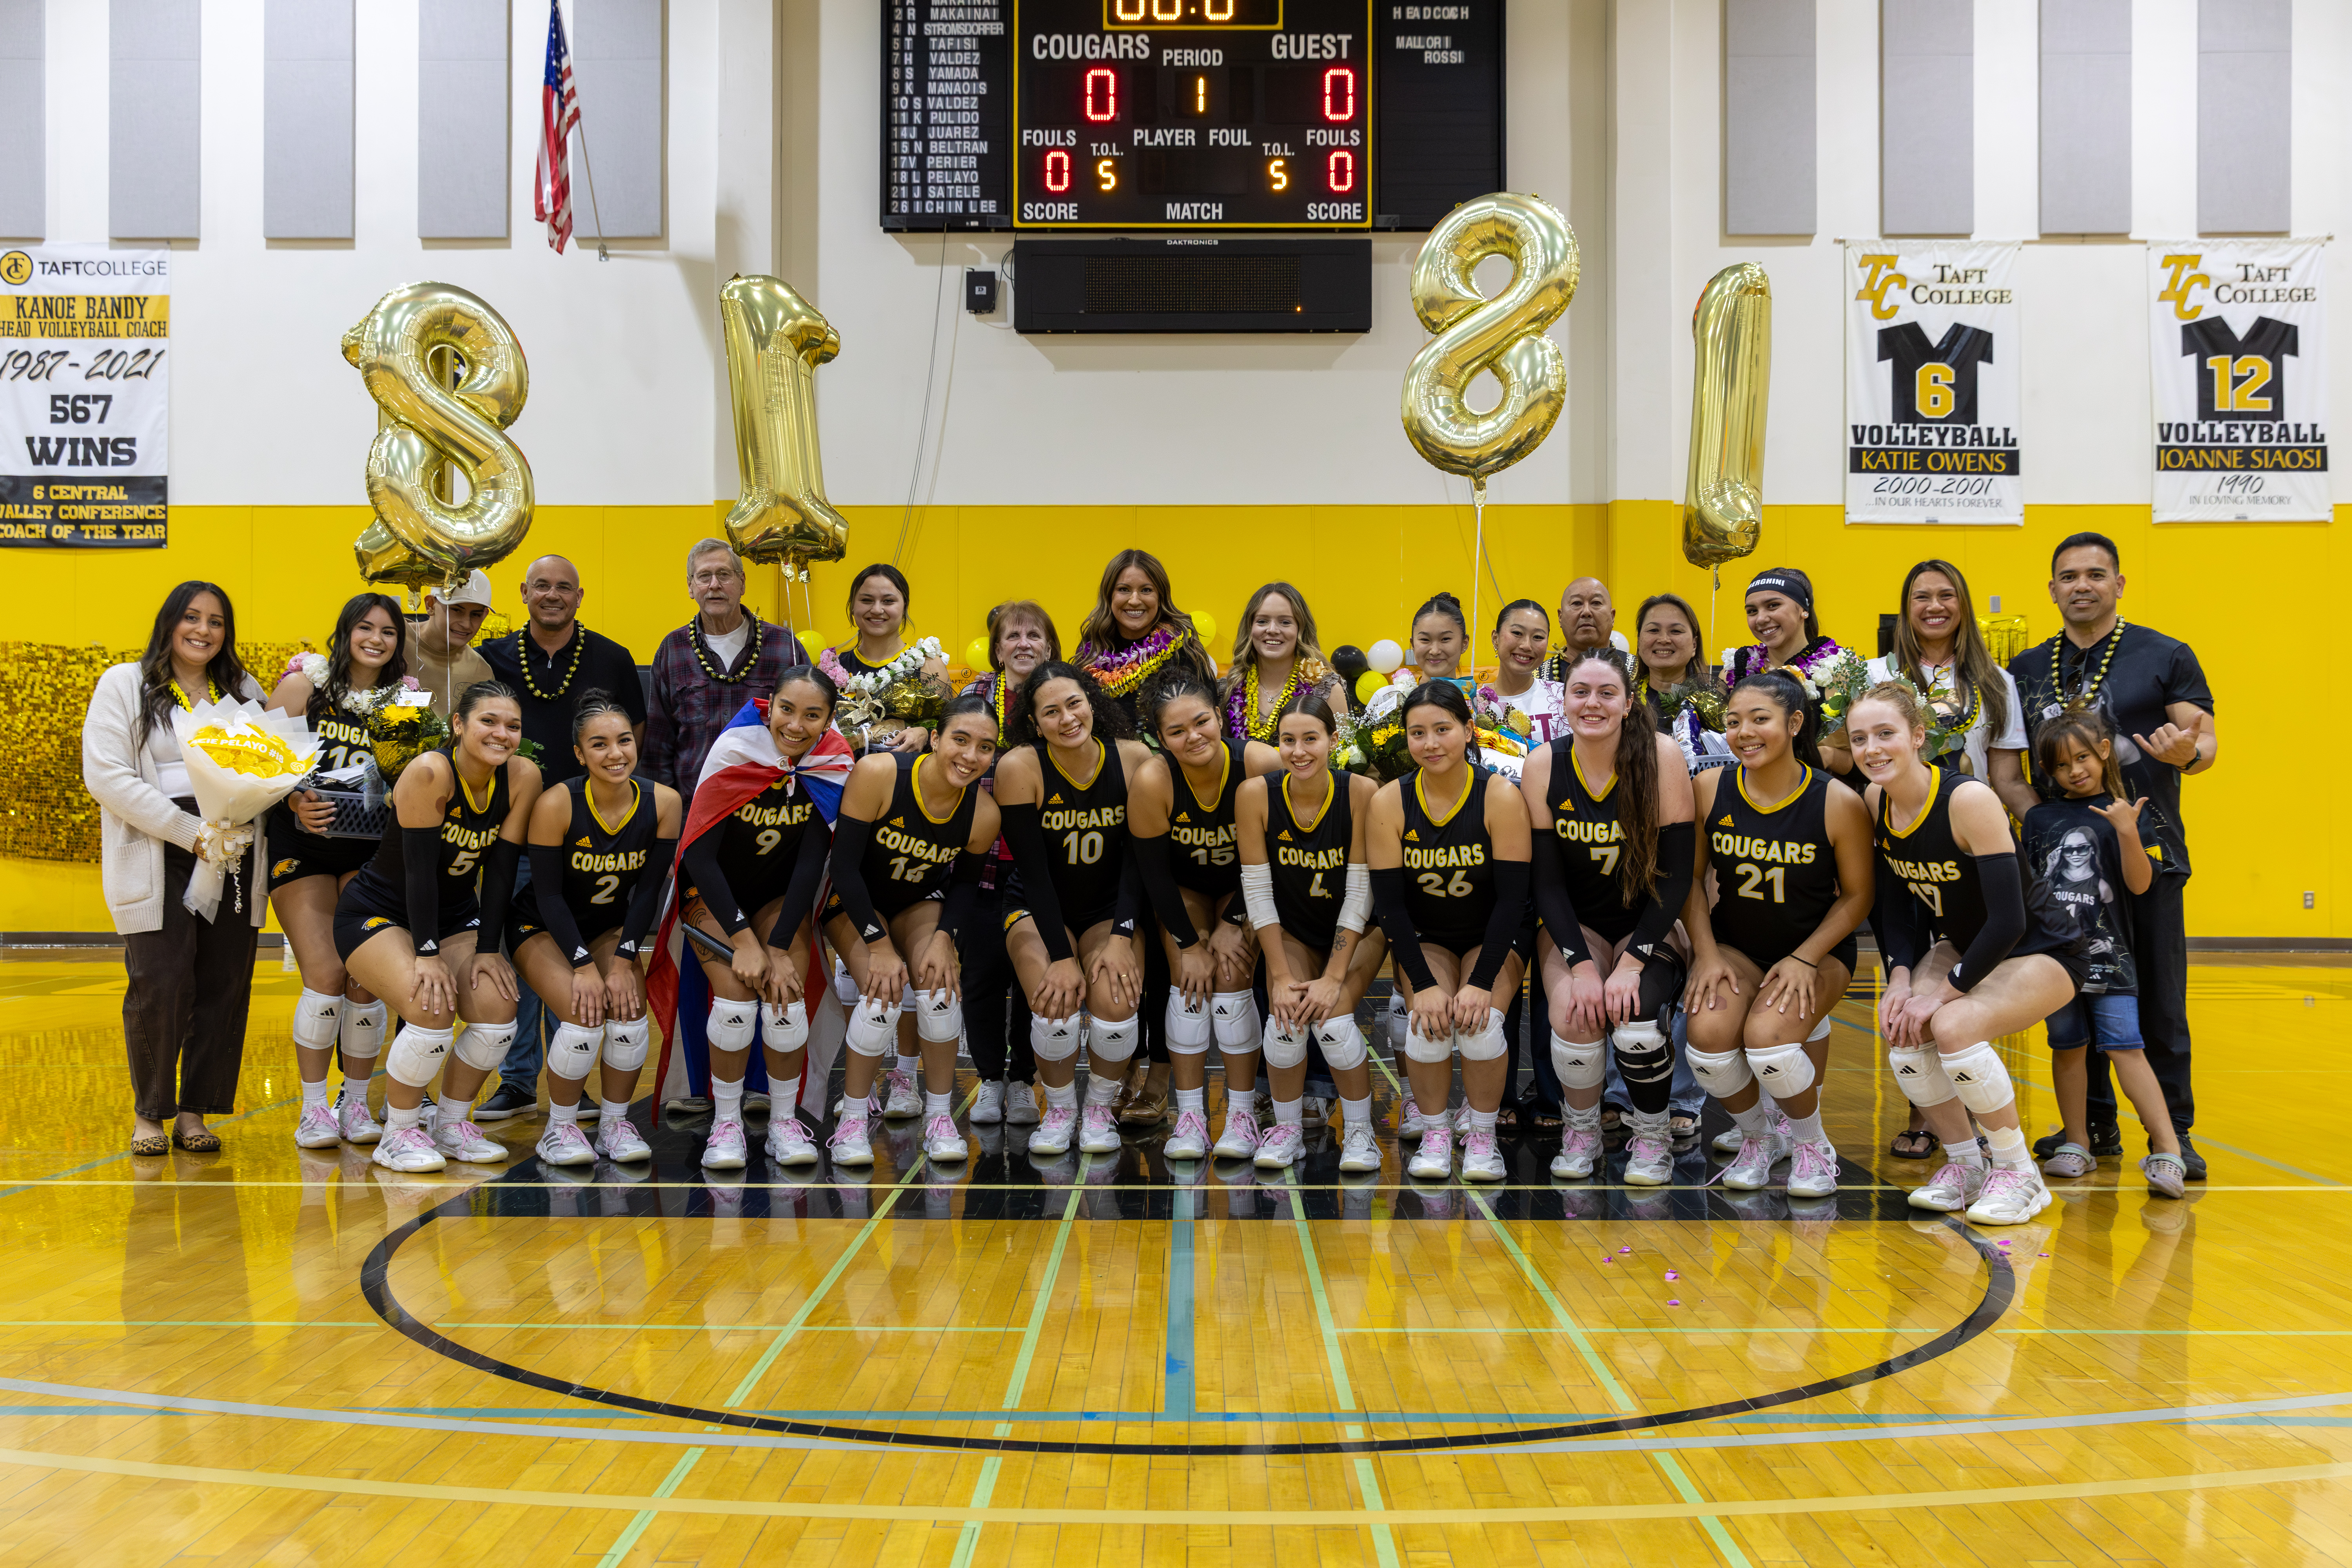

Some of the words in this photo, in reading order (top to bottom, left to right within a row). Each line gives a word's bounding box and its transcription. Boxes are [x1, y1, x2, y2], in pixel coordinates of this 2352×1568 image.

[894, 7, 902, 20] 2
[907, 7, 916, 20] R
[931, 7, 999, 20] MAKAINAI
[893, 22, 900, 35] 4
[907, 22, 916, 35] N
[924, 22, 1004, 35] STROMSDORFER
[893, 38, 900, 50] 5
[904, 38, 913, 50] T
[929, 38, 978, 50] TAFISI
[1033, 34, 1150, 60] COUGARS
[1271, 34, 1352, 60] GUEST
[893, 52, 900, 65] 7
[904, 52, 913, 65] H
[929, 52, 980, 65] VALDEZ
[1163, 49, 1223, 66] PERIOD
[1425, 50, 1463, 64] ROSSI
[893, 67, 900, 80] 8
[905, 67, 914, 80] S
[929, 67, 979, 80] YAMADA
[893, 82, 900, 94] 9
[905, 82, 914, 94] K
[928, 82, 987, 94] MANAOIS
[1086, 69, 1115, 121] 0
[1198, 77, 1205, 113] 1
[1325, 68, 1354, 121] 0
[894, 97, 908, 109] 10
[913, 97, 921, 109] S
[927, 97, 978, 109] VALDEZ
[894, 111, 908, 124] 11
[913, 111, 921, 124] K
[931, 111, 979, 124] PULIDO
[893, 126, 907, 139] 14
[909, 126, 917, 139] J
[928, 126, 979, 139] JUAREZ
[1023, 130, 1077, 146] FOULS
[1133, 129, 1196, 146] PLAYER
[1209, 129, 1251, 146] FOUL
[1306, 130, 1361, 146] FOULS
[894, 141, 909, 154] 15
[914, 141, 922, 154] N
[930, 141, 988, 154] BELTRAN
[1091, 144, 1123, 156] T.O.L.
[1263, 144, 1295, 156] T.O.L.
[894, 156, 906, 168] 17
[909, 156, 916, 168] V
[927, 156, 976, 168] PERIER
[1046, 151, 1069, 191] 0
[1330, 151, 1352, 191] 0
[893, 171, 907, 183] 18
[913, 171, 920, 183] L
[928, 171, 979, 183] PELAYO
[1098, 160, 1116, 191] 5
[1269, 160, 1287, 191] 5
[892, 185, 907, 198] 21
[914, 185, 920, 198] J
[928, 185, 980, 198] SATELE
[1024, 203, 1078, 220] SCORE
[1166, 203, 1223, 220] MATCH
[1307, 203, 1362, 220] SCORE
[15, 297, 76, 319] KANOE
[85, 297, 149, 319] BANDY
[39, 321, 120, 337] VOLLEYBALL
[127, 321, 167, 337] COACH
[1915, 362, 1955, 419] 6
[2206, 354, 2273, 412] 12
[50, 394, 113, 424] 567
[1851, 425, 2017, 447] VOLLEYBALL
[2157, 423, 2325, 443] VOLLEYBALL
[25, 436, 137, 466] WINS
[1861, 451, 1921, 470] KATIE
[1927, 452, 2006, 472] OWENS
[2159, 449, 2246, 470] JOANNE
[2250, 449, 2321, 469] SIAOSI
[33, 485, 45, 500] 6
[49, 485, 129, 500] CENTRAL
[2218, 474, 2264, 494] 1990
[1888, 497, 1911, 506] OUR
[1915, 498, 1954, 507] HEARTS
[1957, 499, 2002, 508] FOREVER
[2190, 495, 2200, 505] IN
[2204, 495, 2243, 505] LOVING
[2247, 496, 2292, 505] MEMORY
[59, 505, 166, 520] CONFERENCE
[51, 524, 75, 539] OF
[80, 524, 117, 539] THE
[122, 524, 165, 539] YEAR
[317, 720, 370, 747] COUGA
[220, 739, 267, 753] PELAYO
[268, 748, 284, 763] #18
[1041, 805, 1125, 830] COUGARS
[1718, 819, 1734, 827] adidas
[1171, 823, 1238, 847] COUGAR
[1555, 818, 1627, 843] COUGA
[756, 829, 781, 855] 9
[876, 826, 962, 863] COUGARS
[1063, 831, 1103, 865] 10
[1712, 831, 1817, 864] COUGARS
[448, 851, 481, 876] 5
[572, 849, 648, 873] COUGARS
[1191, 845, 1235, 866] 15
[1404, 844, 1485, 869] COUGARS
[1590, 846, 1620, 876] 7
[889, 856, 933, 883] 14
[590, 875, 620, 904] 2
[1417, 870, 1474, 898] 26
[1735, 863, 1785, 903] 21
[1907, 882, 1944, 917] 17
